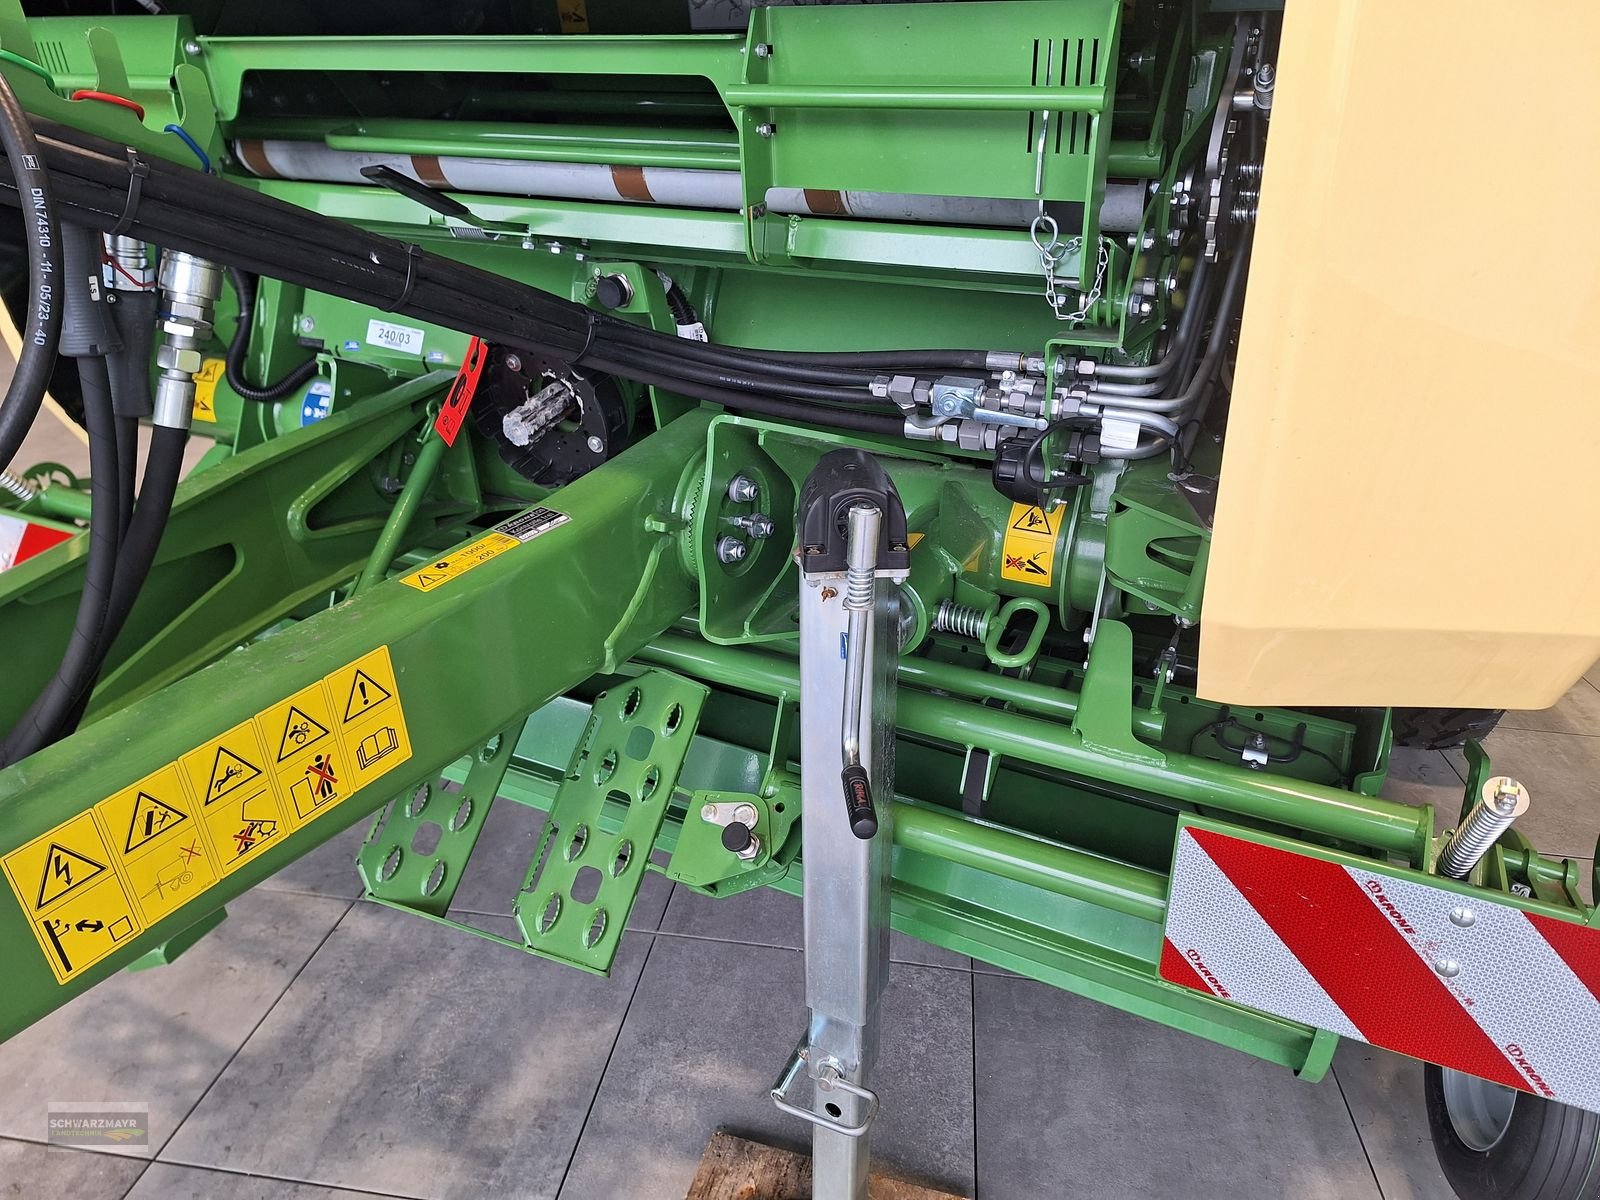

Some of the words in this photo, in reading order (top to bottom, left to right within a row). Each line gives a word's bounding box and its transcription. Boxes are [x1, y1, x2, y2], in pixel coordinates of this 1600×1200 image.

[31, 188, 46, 209] DIN
[36, 210, 50, 247] 74310
[378, 328, 411, 344] 240/03
[478, 549, 495, 561] 200
[1375, 893, 1416, 935] KRONE
[1195, 962, 1231, 998] KRONE
[1515, 1058, 1556, 1097] KRONE
